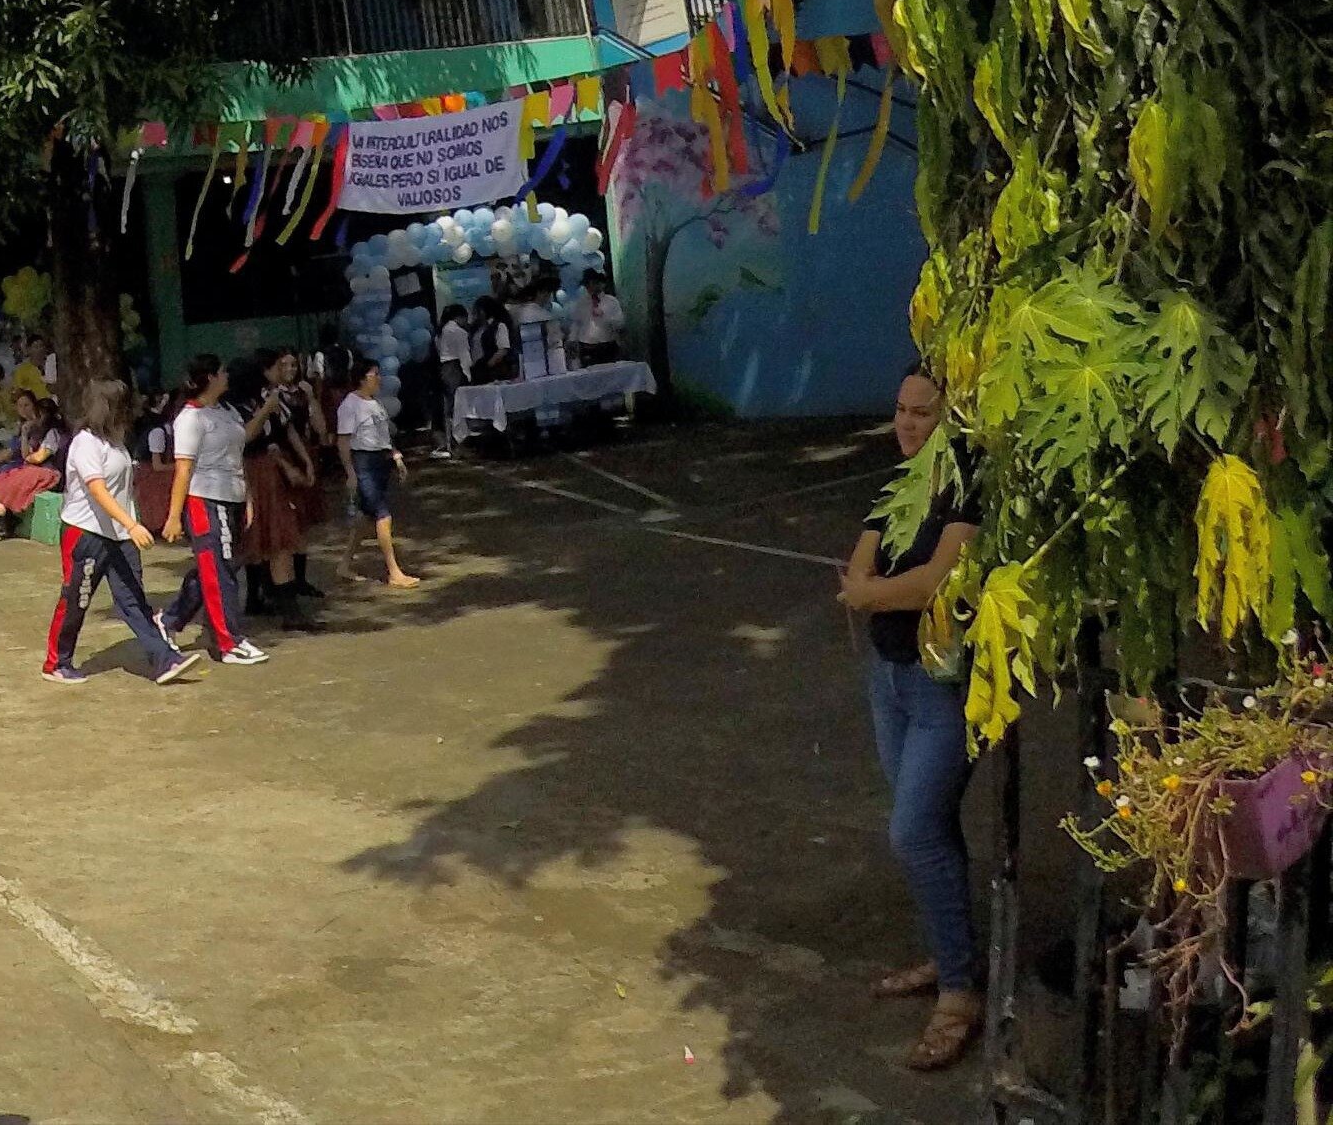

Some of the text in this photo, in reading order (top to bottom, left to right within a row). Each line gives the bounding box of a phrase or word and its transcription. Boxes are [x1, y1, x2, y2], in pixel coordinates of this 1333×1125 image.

[482, 111, 508, 133] NOS
[390, 152, 414, 170] QUE
[416, 150, 433, 166] NO
[437, 140, 483, 163] SOMOS
[391, 171, 423, 188] PERO
[444, 161, 481, 182] IGUAL
[485, 155, 505, 174] DE
[397, 185, 461, 207] VALIOSOS
